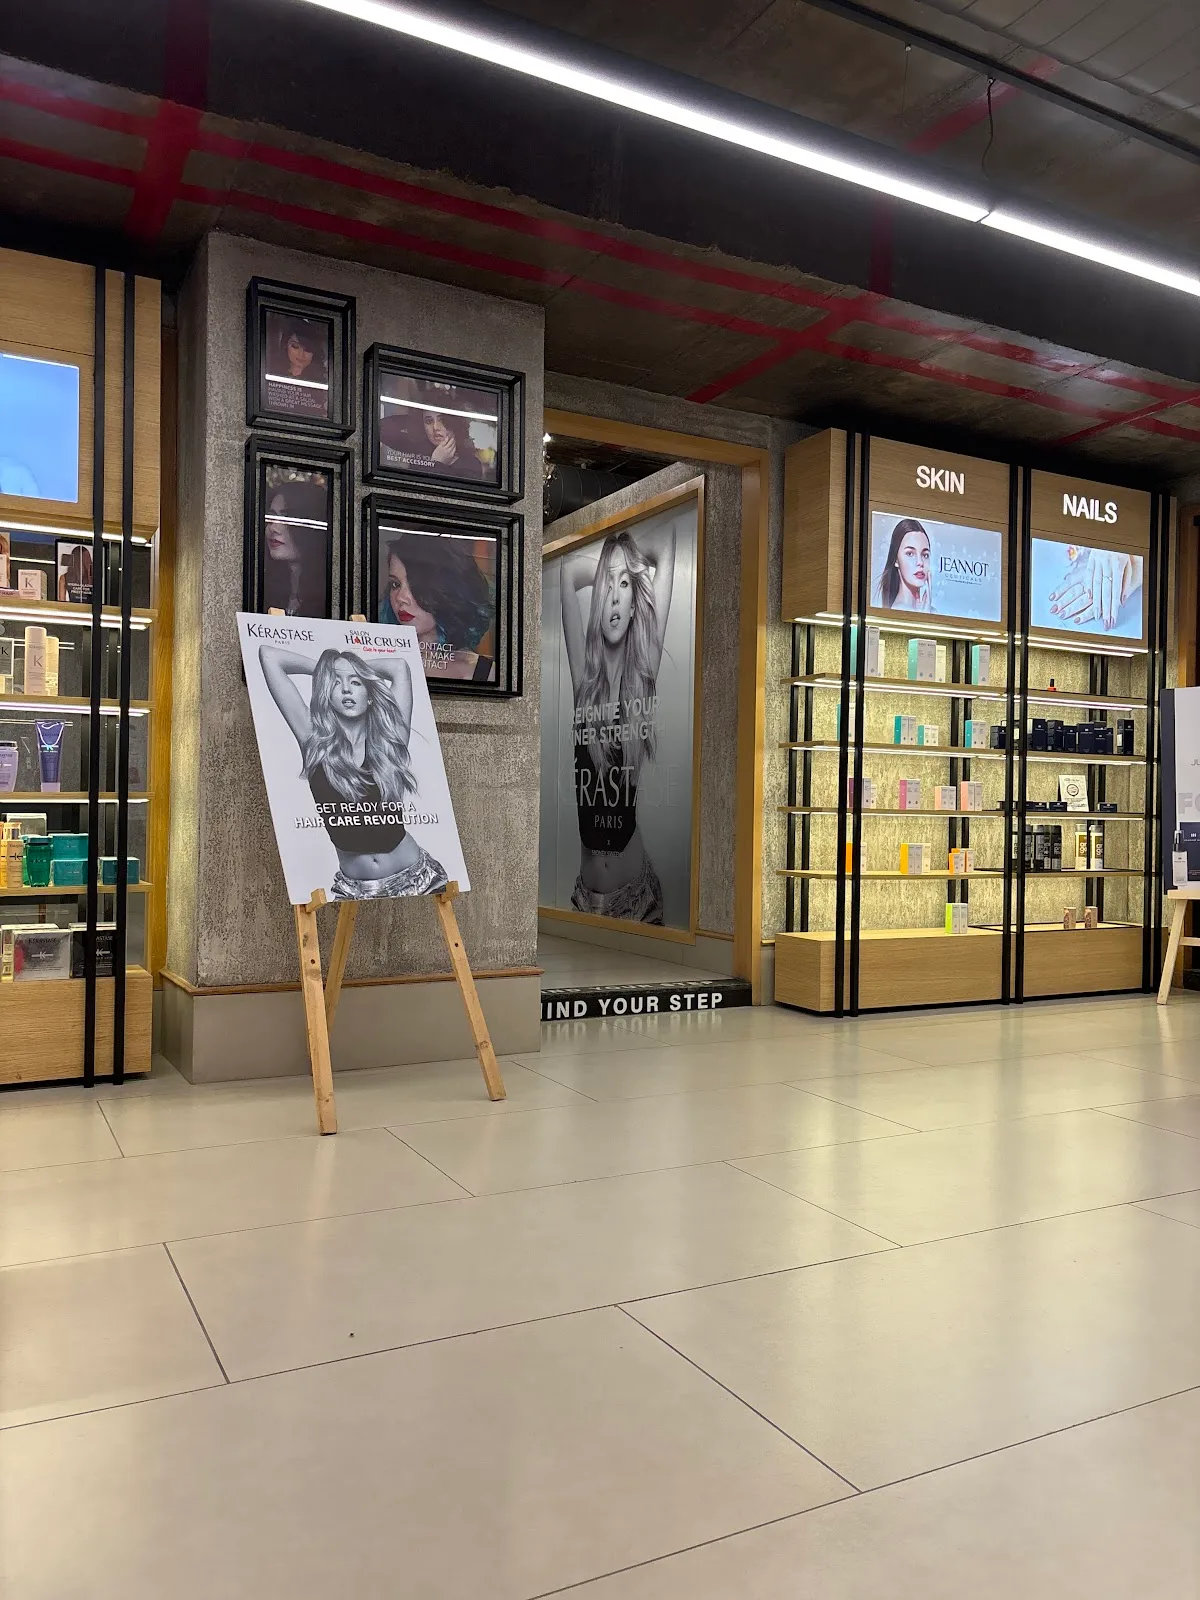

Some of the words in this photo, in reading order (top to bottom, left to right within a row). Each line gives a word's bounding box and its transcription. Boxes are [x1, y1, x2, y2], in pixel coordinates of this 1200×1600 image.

[268, 382, 296, 391] HAPPINESS
[402, 457, 436, 468] ACCESSORY
[915, 465, 965, 495] SKIN
[1062, 493, 1118, 524] NAILS
[938, 556, 990, 577] JEANNOT
[246, 623, 315, 642] KÉRASTASE
[349, 629, 370, 637] SALON
[344, 634, 373, 646] HAIR
[374, 636, 412, 648] CRUSH
[419, 641, 454, 652] ONTACT
[430, 651, 455, 662] MAKE
[624, 695, 661, 718] YOUR
[314, 802, 337, 814] GET
[340, 802, 379, 813] READY
[381, 801, 406, 812] FOR
[408, 801, 417, 812] A
[293, 816, 326, 828] HAIR
[328, 815, 362, 827] CARE
[364, 813, 439, 826] REVOLUTION
[594, 815, 623, 829] PARIS
[540, 1000, 588, 1020] IND
[598, 996, 659, 1015] YOUR
[669, 992, 723, 1012] STEP
